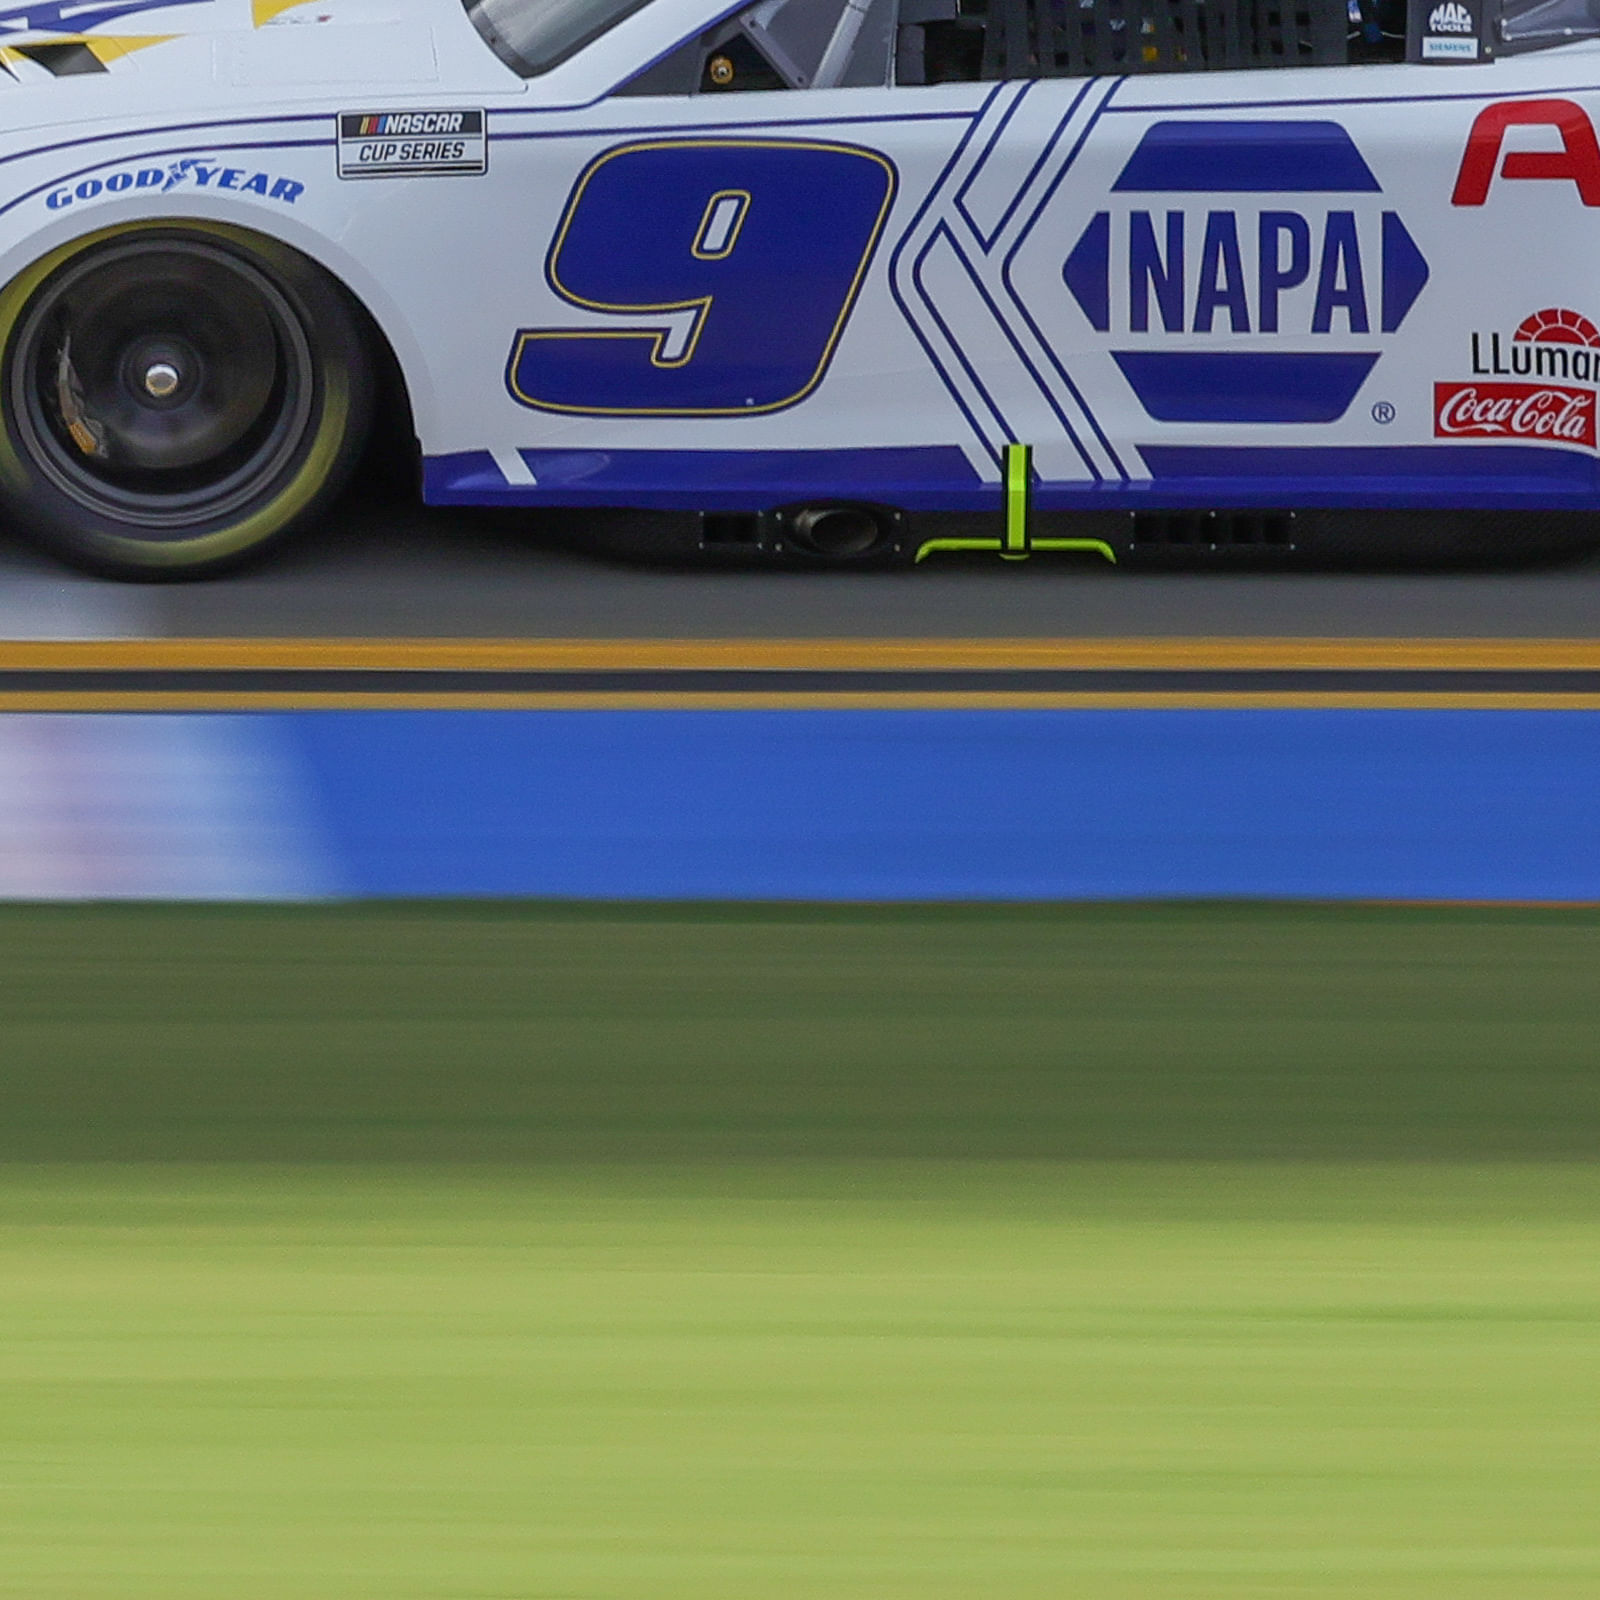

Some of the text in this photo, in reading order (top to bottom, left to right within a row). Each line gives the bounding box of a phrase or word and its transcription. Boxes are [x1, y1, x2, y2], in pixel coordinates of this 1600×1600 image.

[1429, 2, 1473, 25] MAC
[384, 113, 463, 133] NASCAR
[358, 141, 466, 162] CUP SERIES
[505, 137, 899, 418] 9
[1128, 210, 1370, 333] NAPA
[1439, 386, 1594, 439] Coca-Cola
